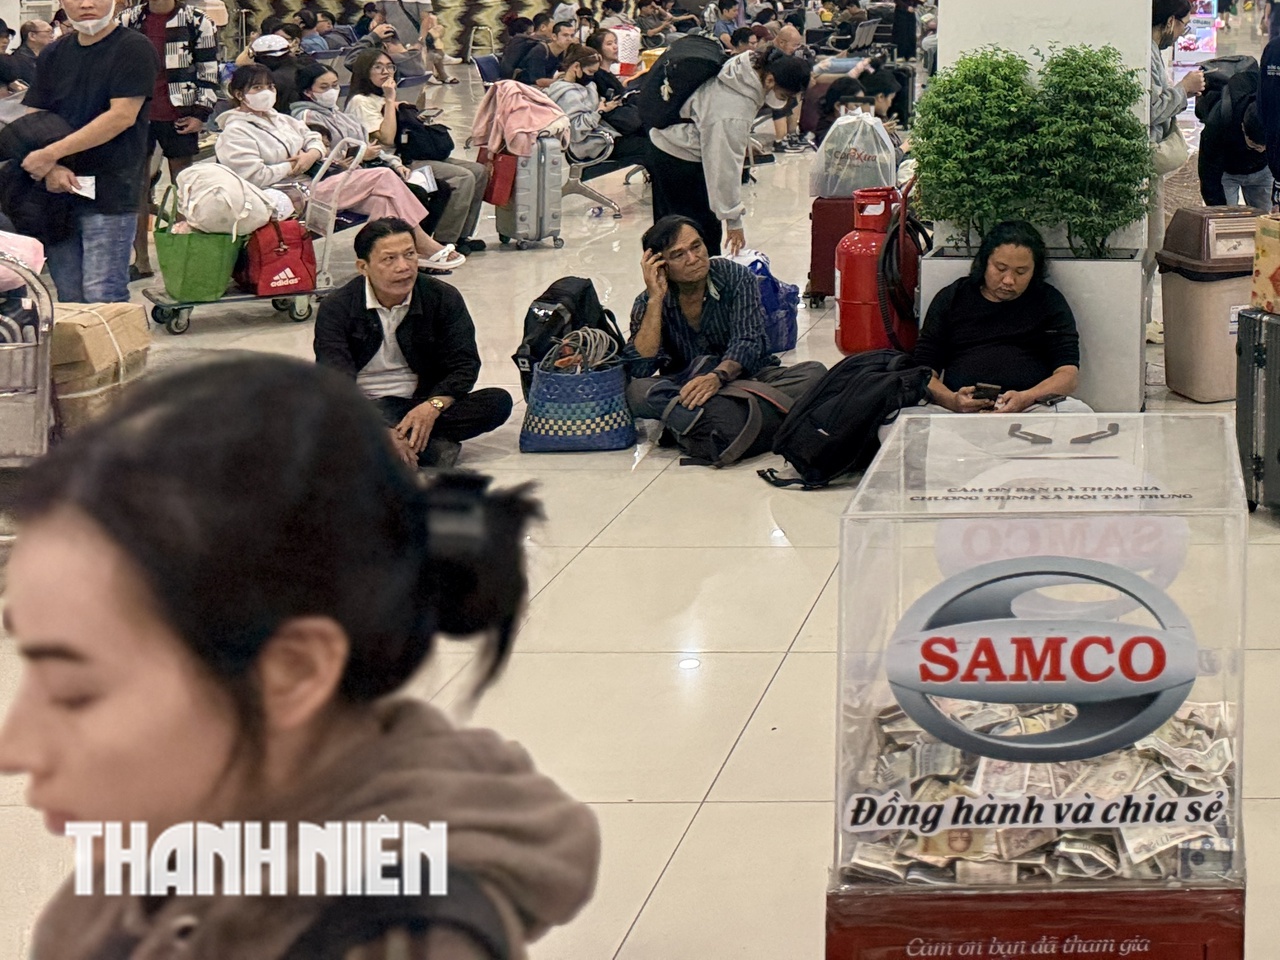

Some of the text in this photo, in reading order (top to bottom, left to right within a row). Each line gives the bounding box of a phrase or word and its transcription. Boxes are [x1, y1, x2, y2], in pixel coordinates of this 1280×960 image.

[271, 279, 299, 287] adidas
[919, 636, 1167, 682] SAMCO
[850, 790, 1224, 834] Đồng hành và chia sẻ
[988, 936, 1026, 957] bạn
[1031, 935, 1059, 955] đã
[1062, 934, 1115, 954] tham
[1119, 934, 1151, 956] gia
